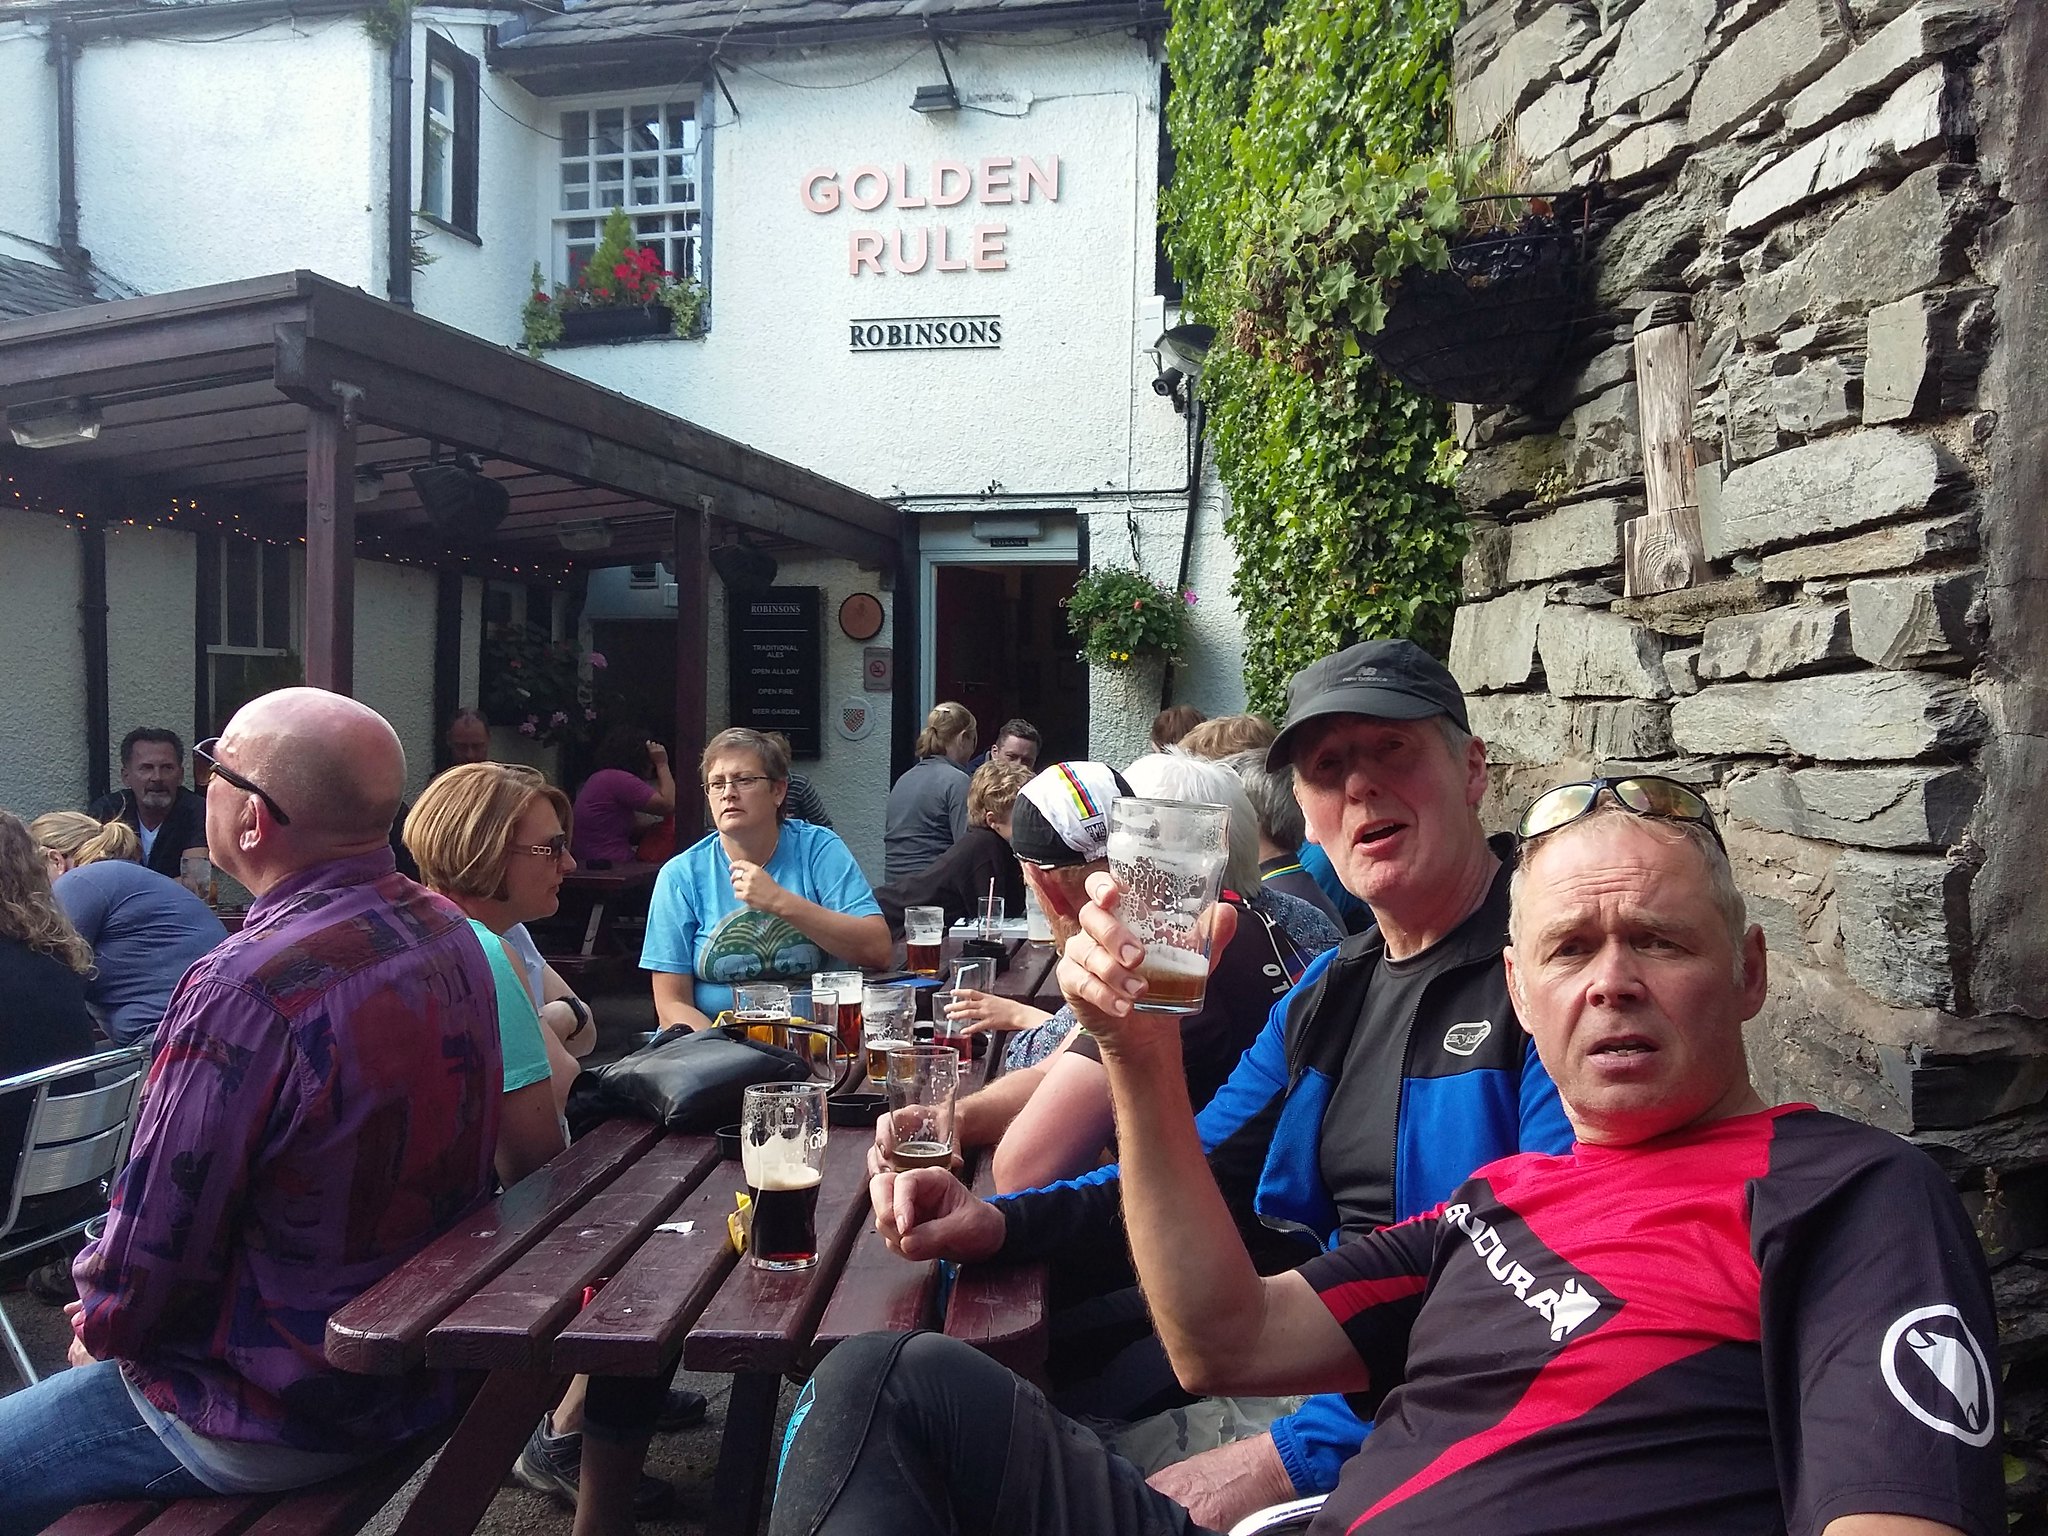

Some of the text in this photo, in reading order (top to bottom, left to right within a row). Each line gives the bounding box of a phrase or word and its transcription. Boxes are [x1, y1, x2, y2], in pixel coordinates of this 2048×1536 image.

[799, 154, 1060, 214] GOLDEN
[850, 223, 1008, 276] RULE
[850, 320, 1001, 347] ROBINSONS
[751, 605, 800, 613] ROBINSONS
